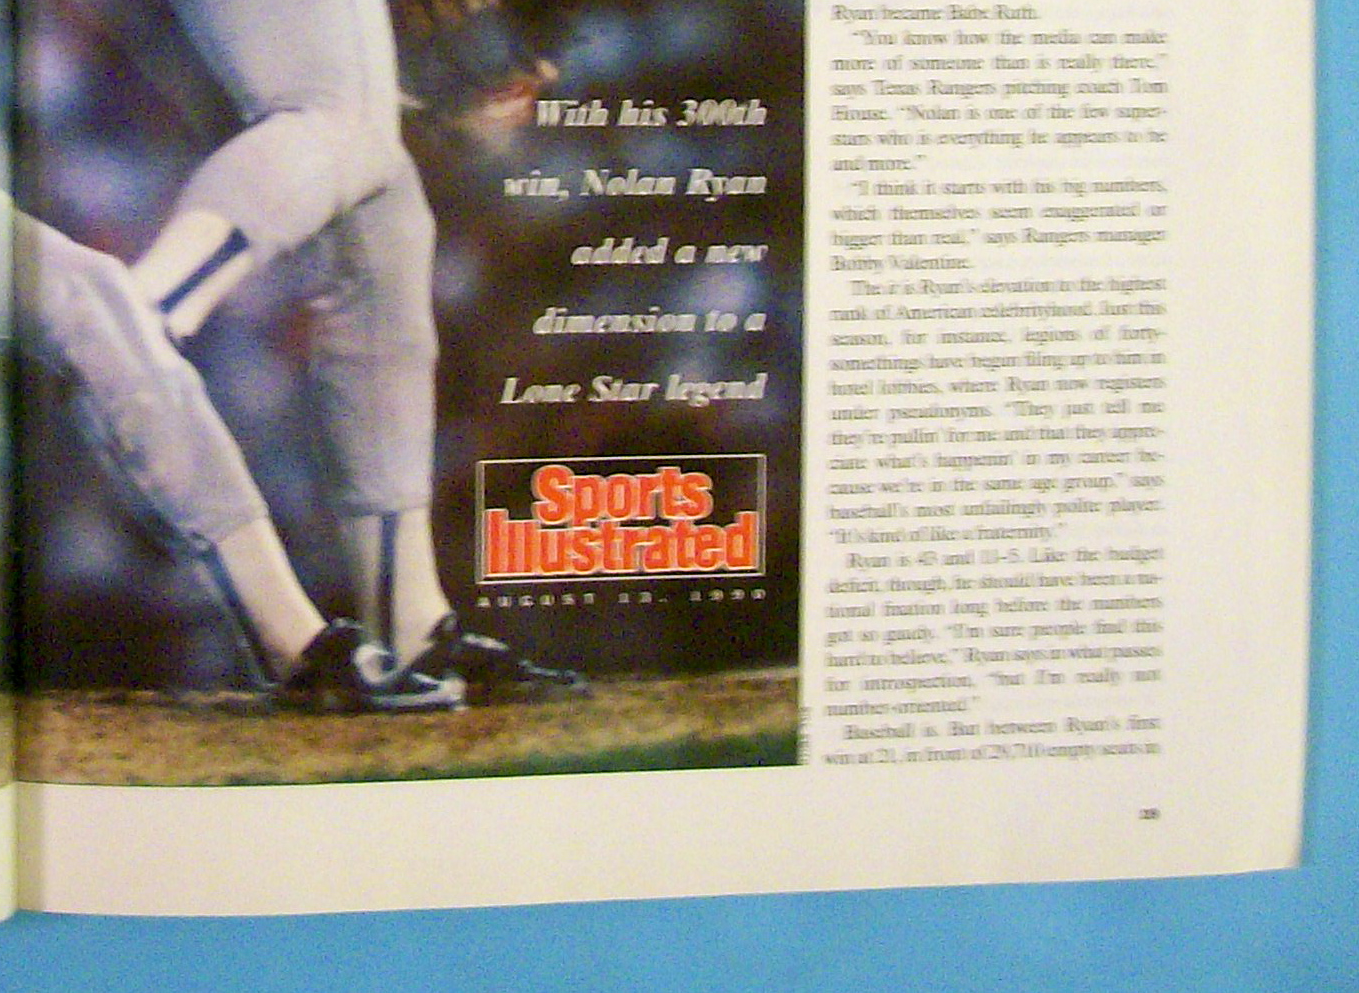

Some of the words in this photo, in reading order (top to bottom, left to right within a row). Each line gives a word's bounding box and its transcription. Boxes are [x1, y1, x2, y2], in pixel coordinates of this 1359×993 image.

[537, 100, 609, 126] With
[616, 99, 668, 126] his
[676, 99, 767, 126] 300th
[503, 169, 569, 202] win,
[580, 168, 676, 196] Nolan
[685, 168, 767, 203] Ryan
[570, 237, 670, 265] added
[674, 245, 697, 264] a
[704, 244, 769, 264] new
[532, 306, 698, 334] dimension
[704, 310, 738, 333] to
[744, 313, 767, 333] a
[499, 377, 581, 404] Lone
[588, 375, 660, 402] Star
[665, 372, 769, 408] legend
[531, 464, 715, 525] Sports
[485, 508, 759, 574] Illustrated
